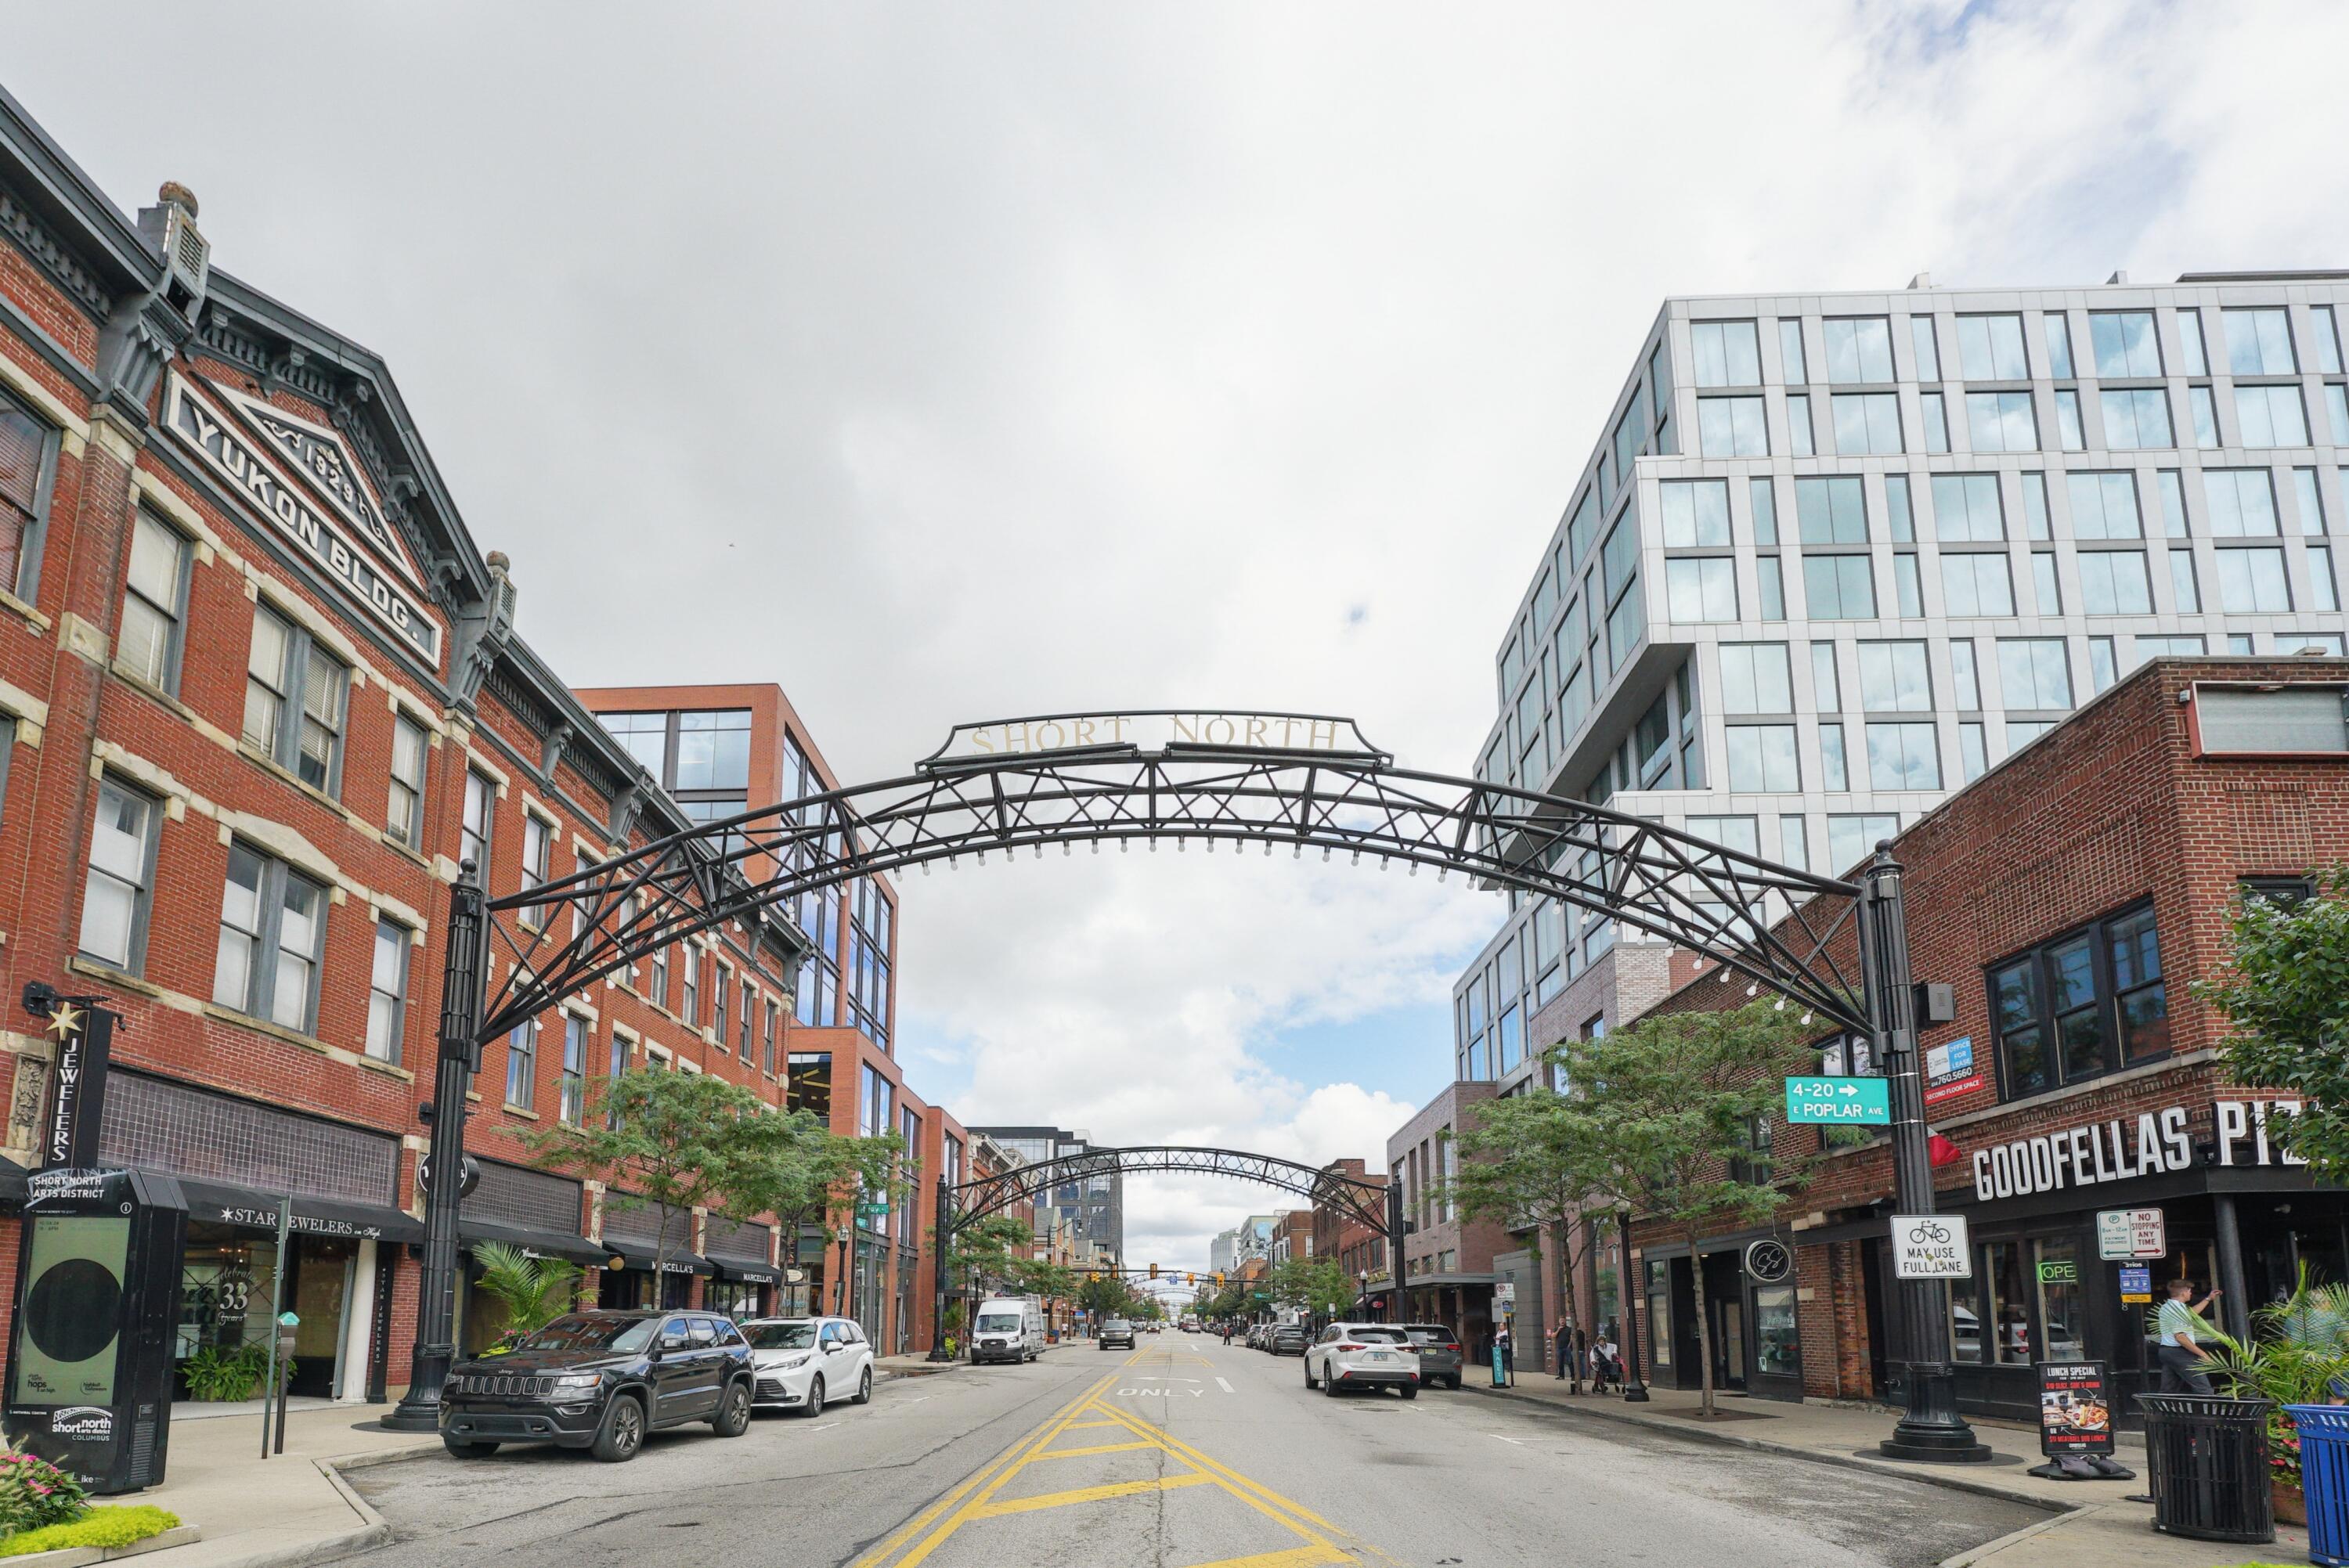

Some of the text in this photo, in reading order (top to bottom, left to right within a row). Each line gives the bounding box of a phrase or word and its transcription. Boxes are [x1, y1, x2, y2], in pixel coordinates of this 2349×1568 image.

[305, 444, 353, 503] 1929
[192, 406, 418, 640] YUKON BLDG.
[971, 716, 1340, 755] SHORT NORTH
[1949, 1040, 1971, 1053] OFFICE
[1952, 1058, 1970, 1069] LEASE
[1937, 1066, 1972, 1085] 760.5660
[1792, 1083, 1834, 1098] 4-20
[1926, 1080, 1979, 1101] SECOND FLOOR SPACE
[52, 1037, 79, 1162] JEWELERS
[1803, 1103, 1863, 1118] POPLAR
[1867, 1107, 1884, 1116] AVE
[1973, 1100, 2333, 1202] GOODFELLAS PIZ
[34, 1176, 102, 1186] SHORT NORTH
[33, 1189, 105, 1199] ARTS DISTRICT
[234, 1207, 277, 1227] STAR
[287, 1215, 353, 1235] EWELERS
[2138, 1213, 2151, 1221] NO
[2131, 1221, 2160, 1231] STOPPING
[1907, 1247, 1955, 1259] MAY USE
[651, 1260, 694, 1274] MRCELLA'S
[1903, 1261, 1963, 1273] FULL LANE
[2042, 1265, 2076, 1278] OPE
[743, 1272, 773, 1284] MARCELLA'S
[219, 1281, 248, 1310] 33
[2047, 1366, 2097, 1377] LUNCH SPECIAL
[27, 1379, 47, 1392] hops
[1115, 1388, 1205, 1397] ONLY
[52, 1416, 112, 1433] short north
[81, 1475, 95, 1483] ike
